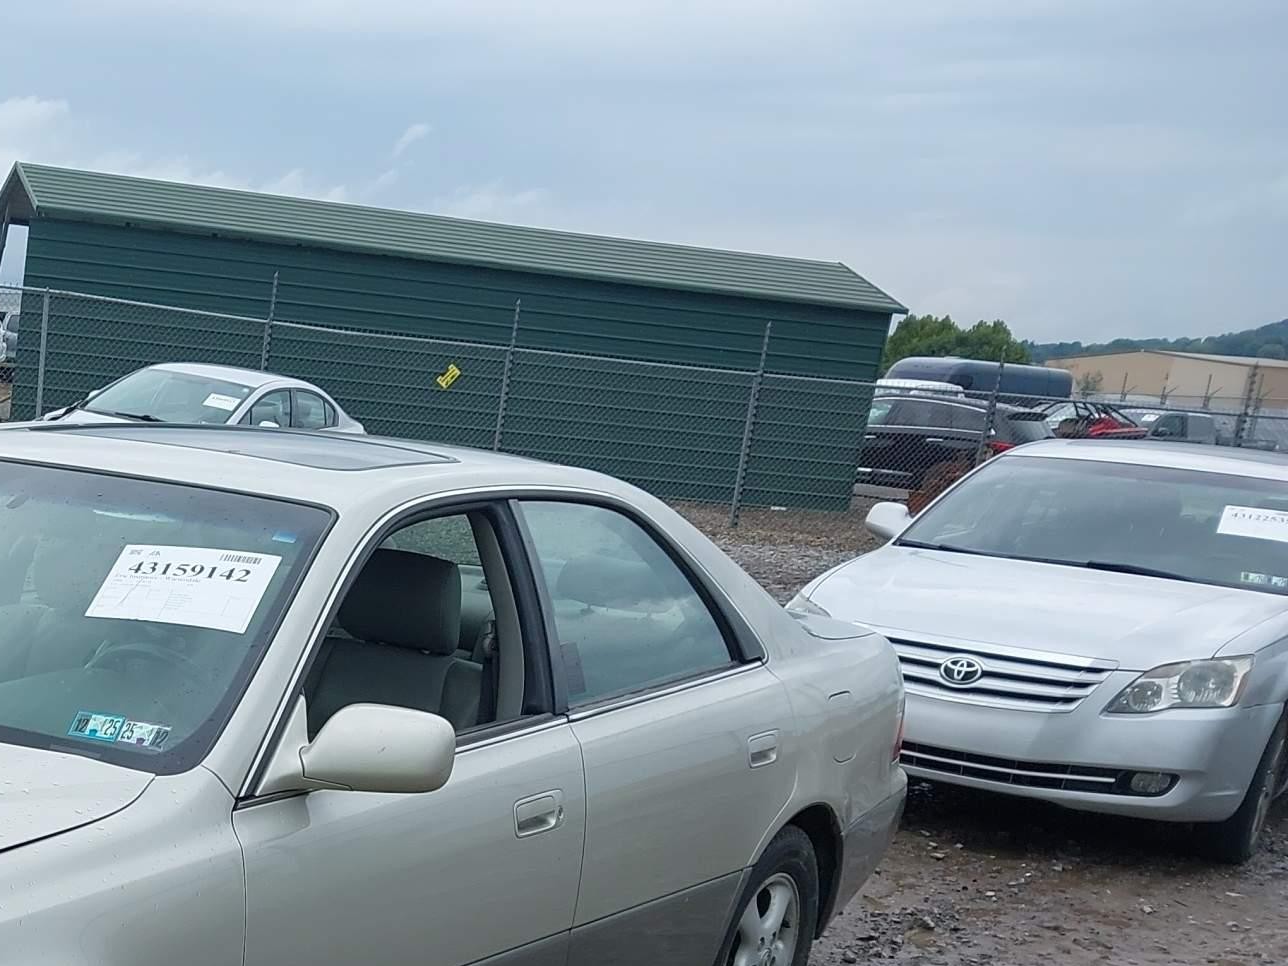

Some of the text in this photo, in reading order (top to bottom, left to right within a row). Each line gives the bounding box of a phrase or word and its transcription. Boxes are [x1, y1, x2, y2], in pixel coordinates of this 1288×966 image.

[128, 561, 252, 583] 43159142
[74, 718, 89, 733] 12
[121, 722, 138, 740] 25
